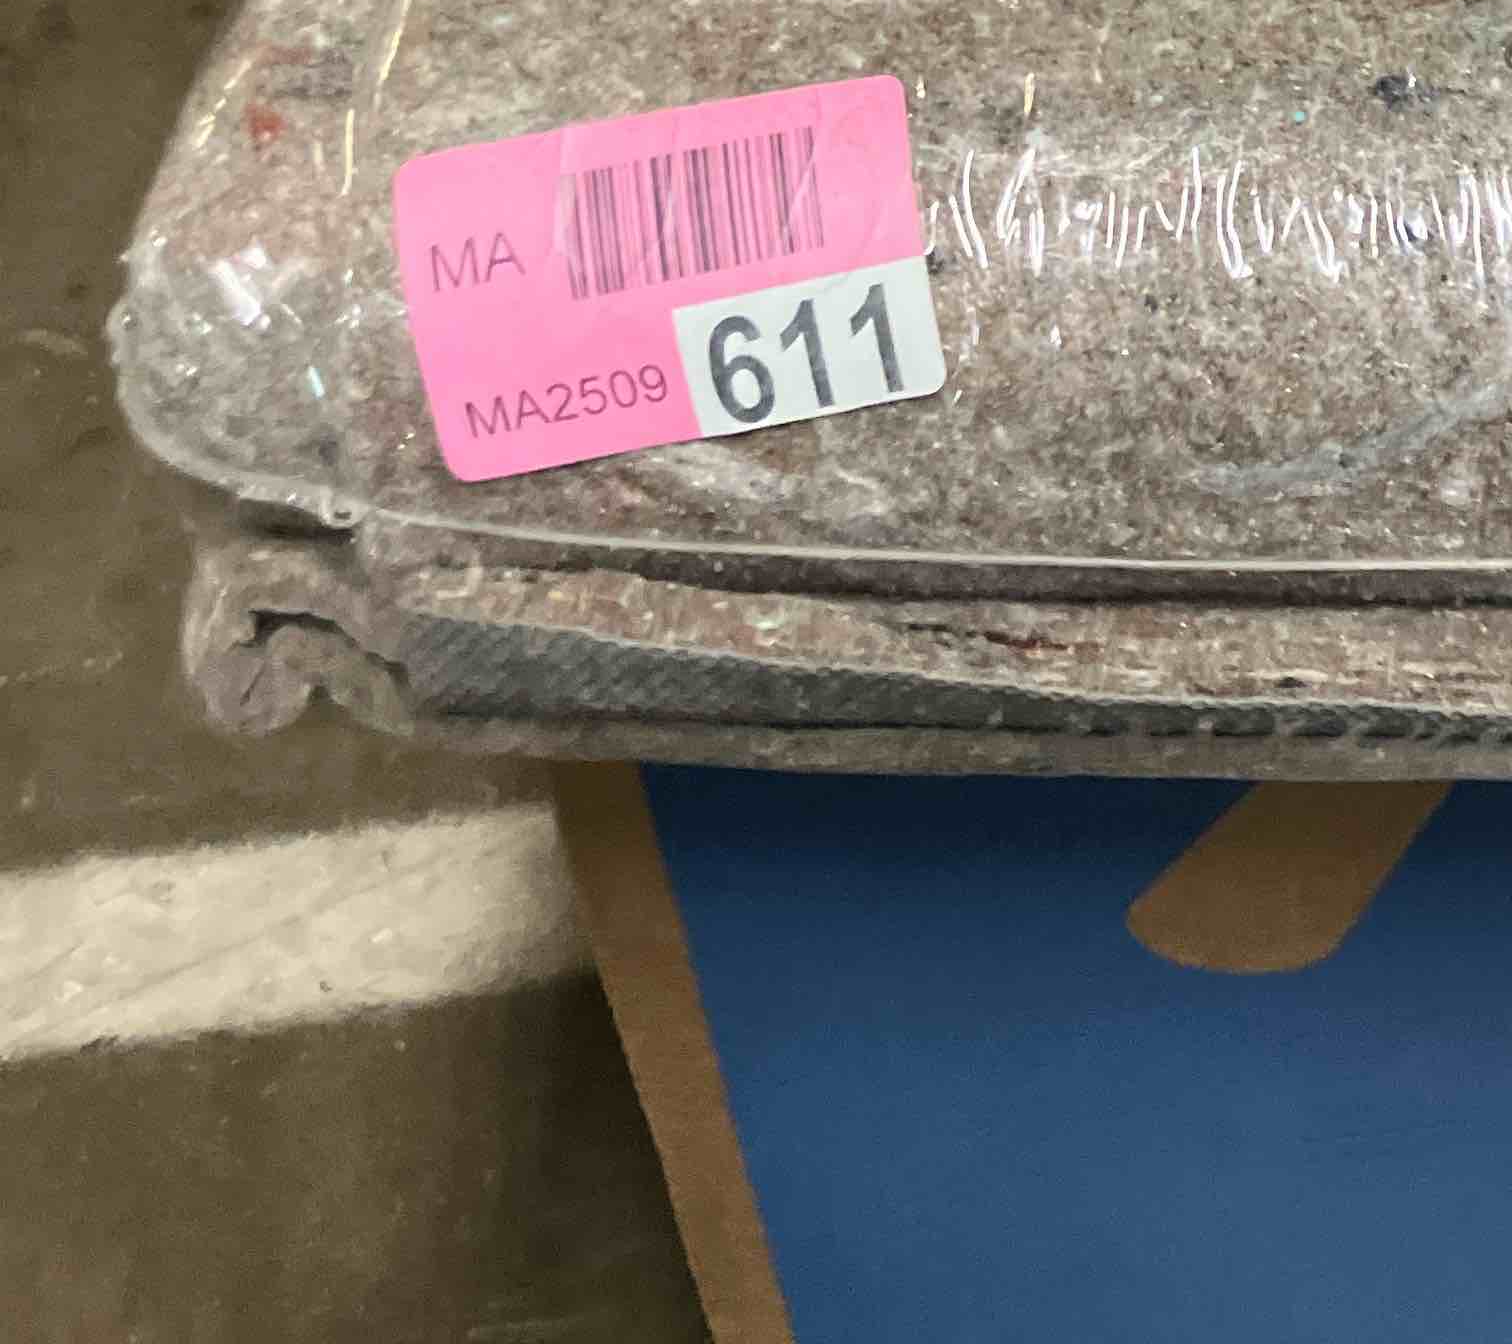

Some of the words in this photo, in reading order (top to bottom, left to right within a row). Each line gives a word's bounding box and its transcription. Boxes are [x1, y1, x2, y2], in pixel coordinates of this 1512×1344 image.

[429, 232, 526, 292] MA
[708, 282, 904, 425] 611
[465, 364, 669, 439] MA2509
